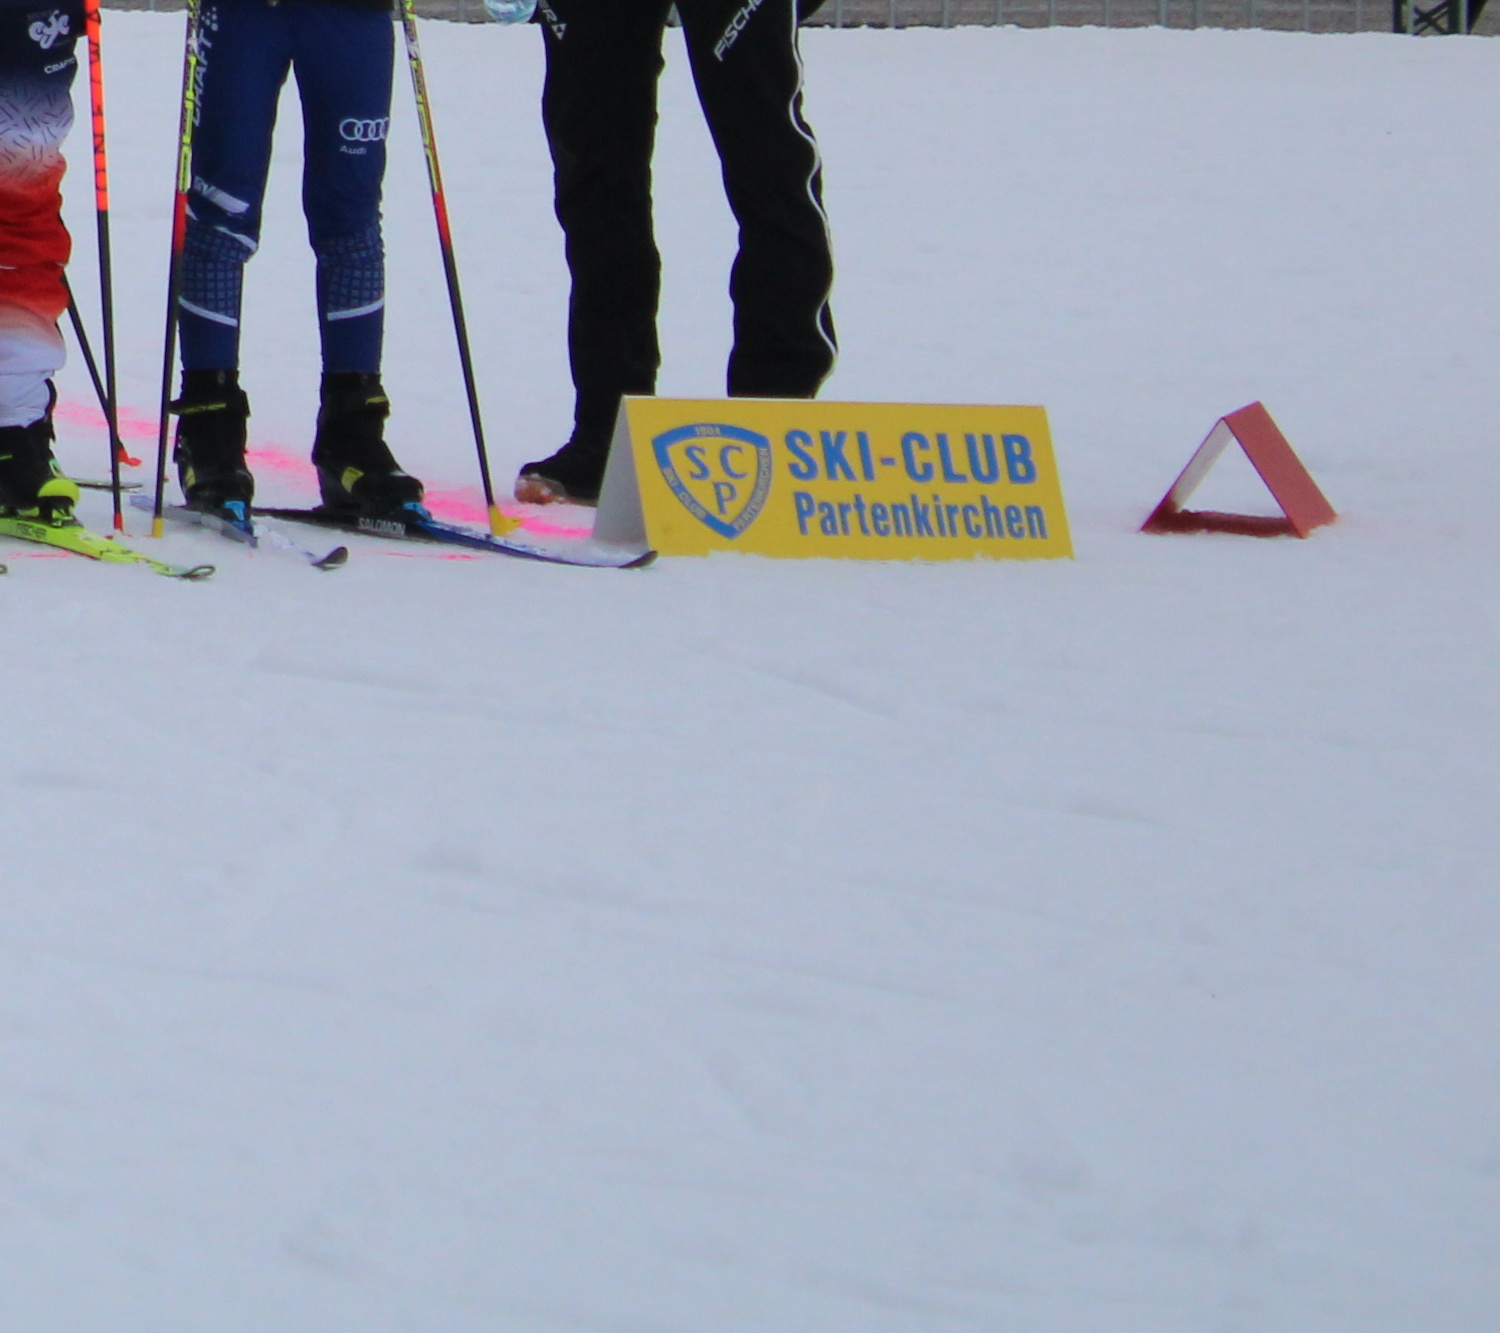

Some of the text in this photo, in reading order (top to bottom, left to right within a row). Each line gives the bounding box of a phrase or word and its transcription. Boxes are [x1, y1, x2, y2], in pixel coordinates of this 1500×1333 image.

[340, 145, 367, 155] Audi
[784, 429, 1039, 485] SKI-CLUB
[358, 516, 406, 536] SALOMON
[793, 491, 1050, 541] Partenkirchen
